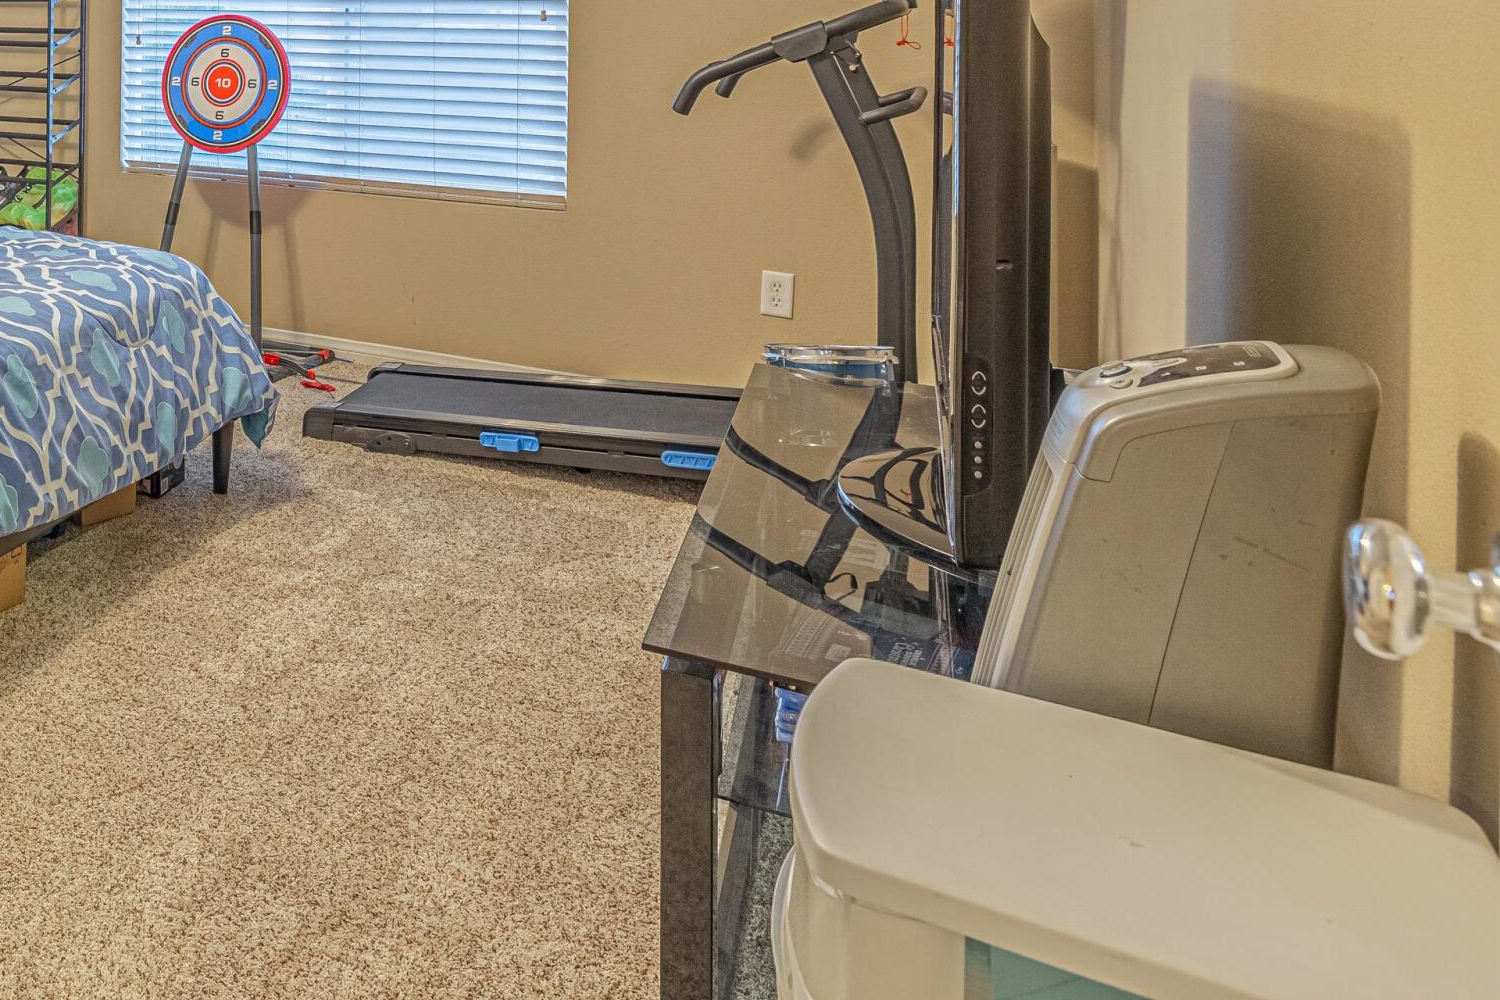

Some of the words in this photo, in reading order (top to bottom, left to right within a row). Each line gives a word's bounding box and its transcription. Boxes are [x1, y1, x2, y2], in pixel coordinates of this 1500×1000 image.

[222, 25, 232, 36] 2
[220, 48, 230, 58] 6
[171, 76, 181, 86] 2
[191, 77, 200, 87] 6
[215, 77, 231, 88] 10
[247, 79, 257, 89] 6
[267, 80, 278, 90] 2
[215, 110, 225, 121] 6
[212, 130, 223, 141] 2
